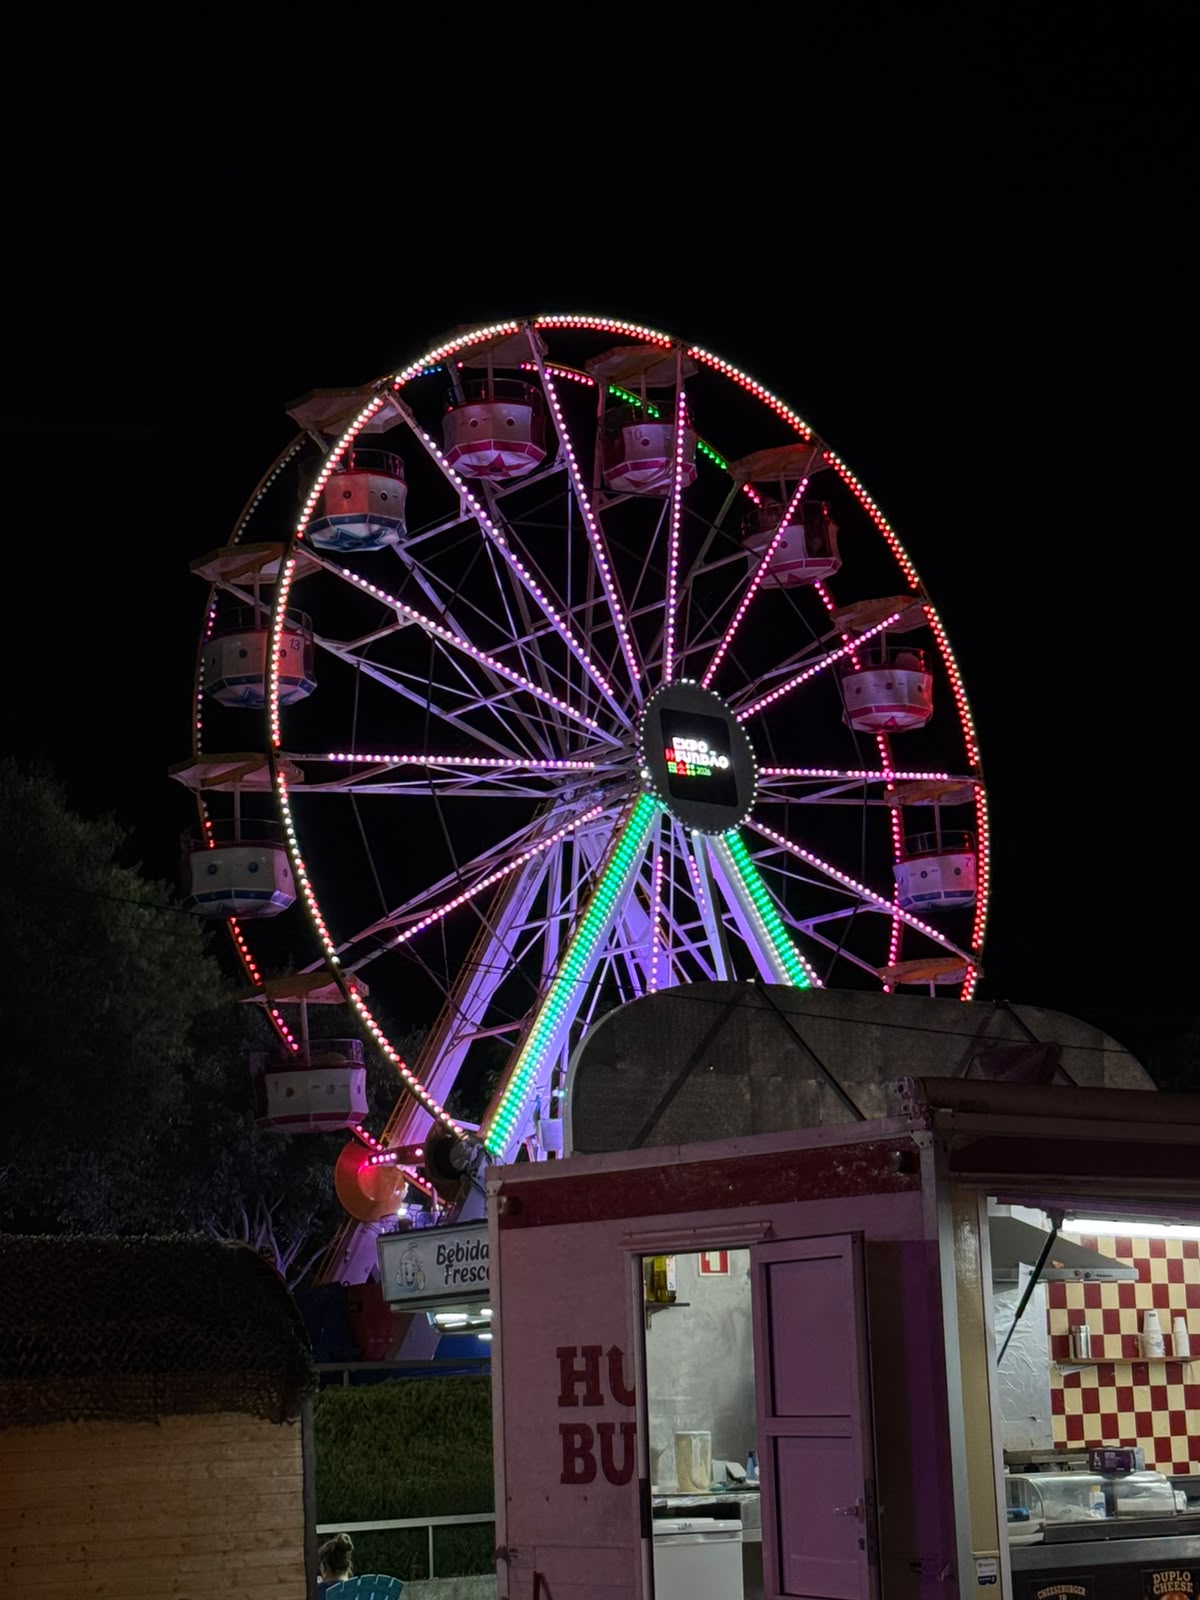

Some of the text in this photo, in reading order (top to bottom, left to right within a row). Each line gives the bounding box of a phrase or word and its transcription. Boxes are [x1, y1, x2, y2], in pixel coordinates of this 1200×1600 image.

[289, 638, 301, 651] 13
[672, 737, 708, 753] EXPO
[675, 750, 729, 769] FUNDÃO
[559, 1422, 637, 1486] BU
[1152, 1570, 1192, 1584] DUPLO
[1153, 1581, 1194, 1595] CHEESE
